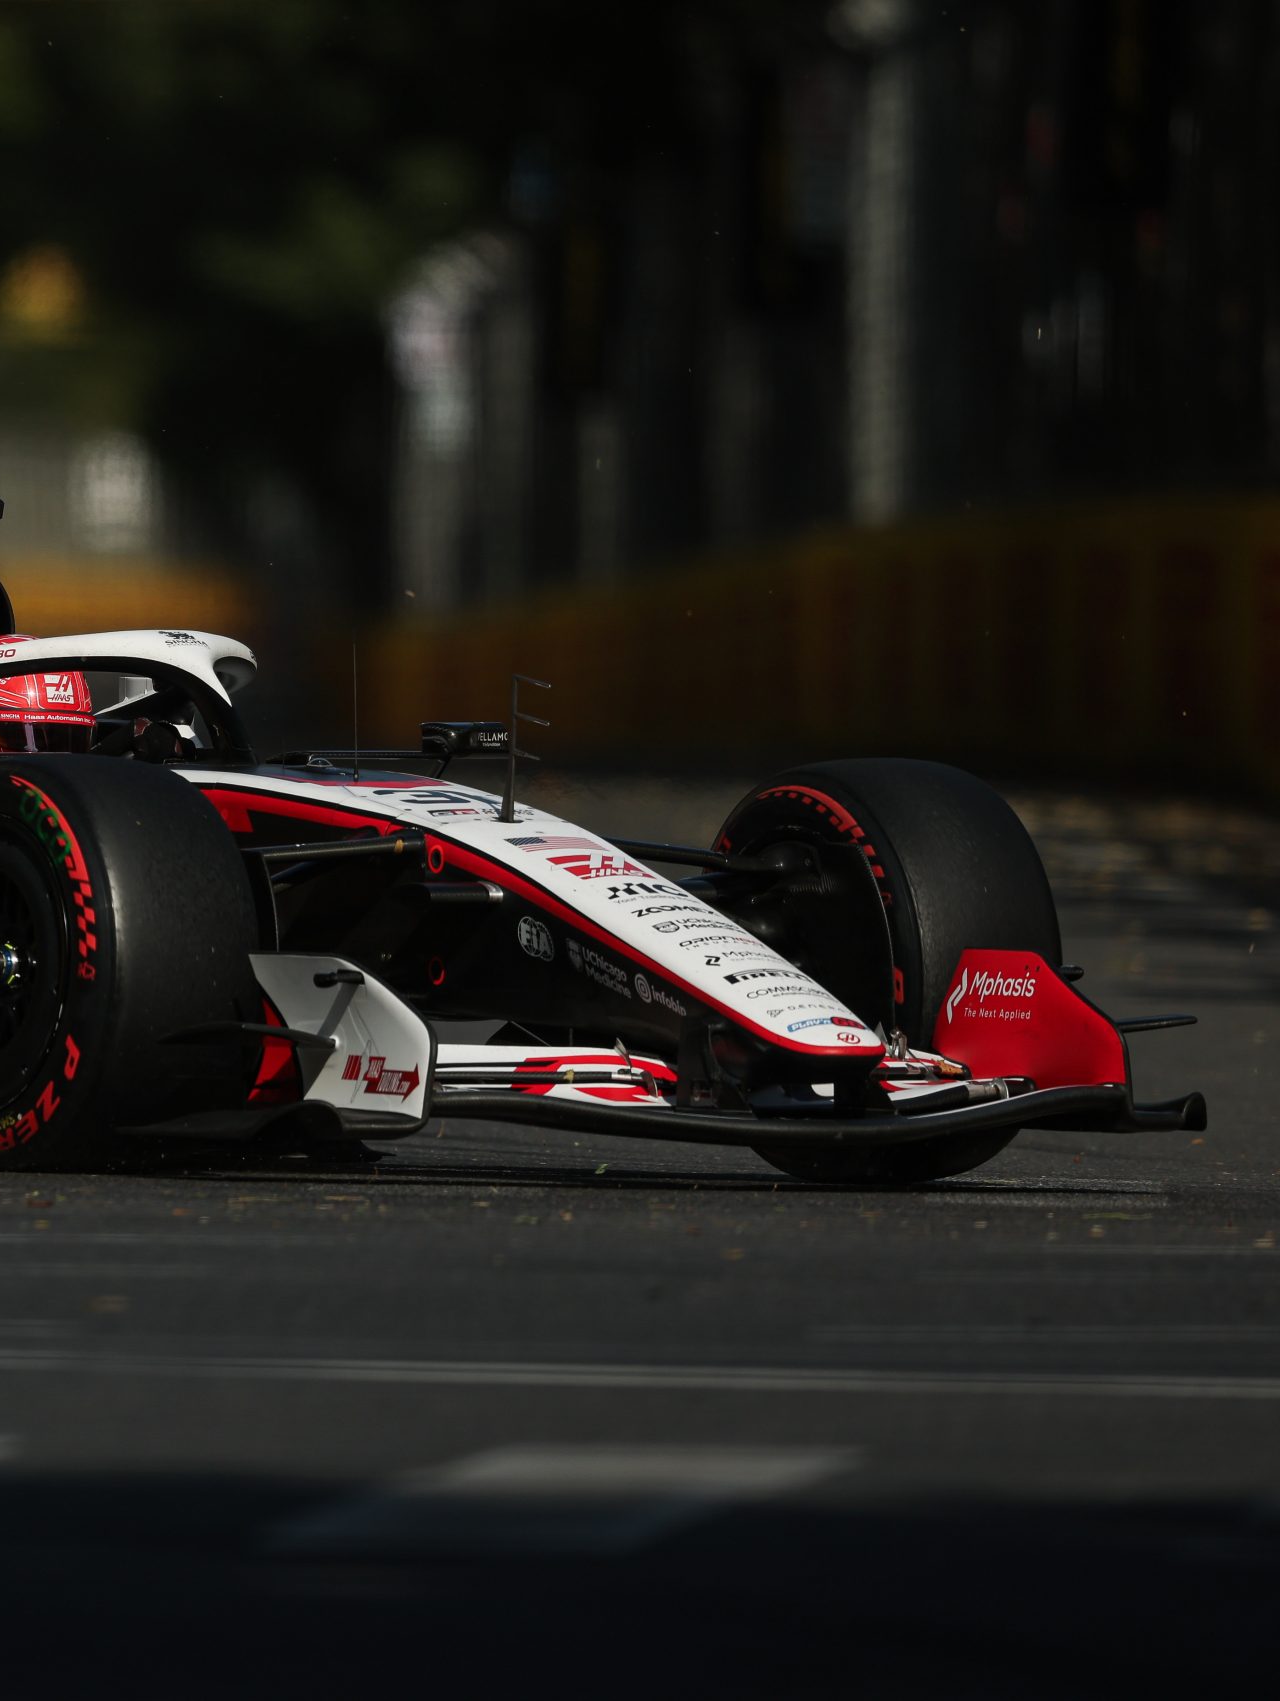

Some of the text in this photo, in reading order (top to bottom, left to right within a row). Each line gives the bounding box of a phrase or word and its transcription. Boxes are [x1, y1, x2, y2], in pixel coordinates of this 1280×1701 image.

[47, 714, 83, 722] Automation
[582, 945, 628, 982] UChicago
[584, 963, 632, 999] Medicine
[969, 971, 1036, 1003] Mphasis
[964, 1008, 1031, 1021] The Next Applied
